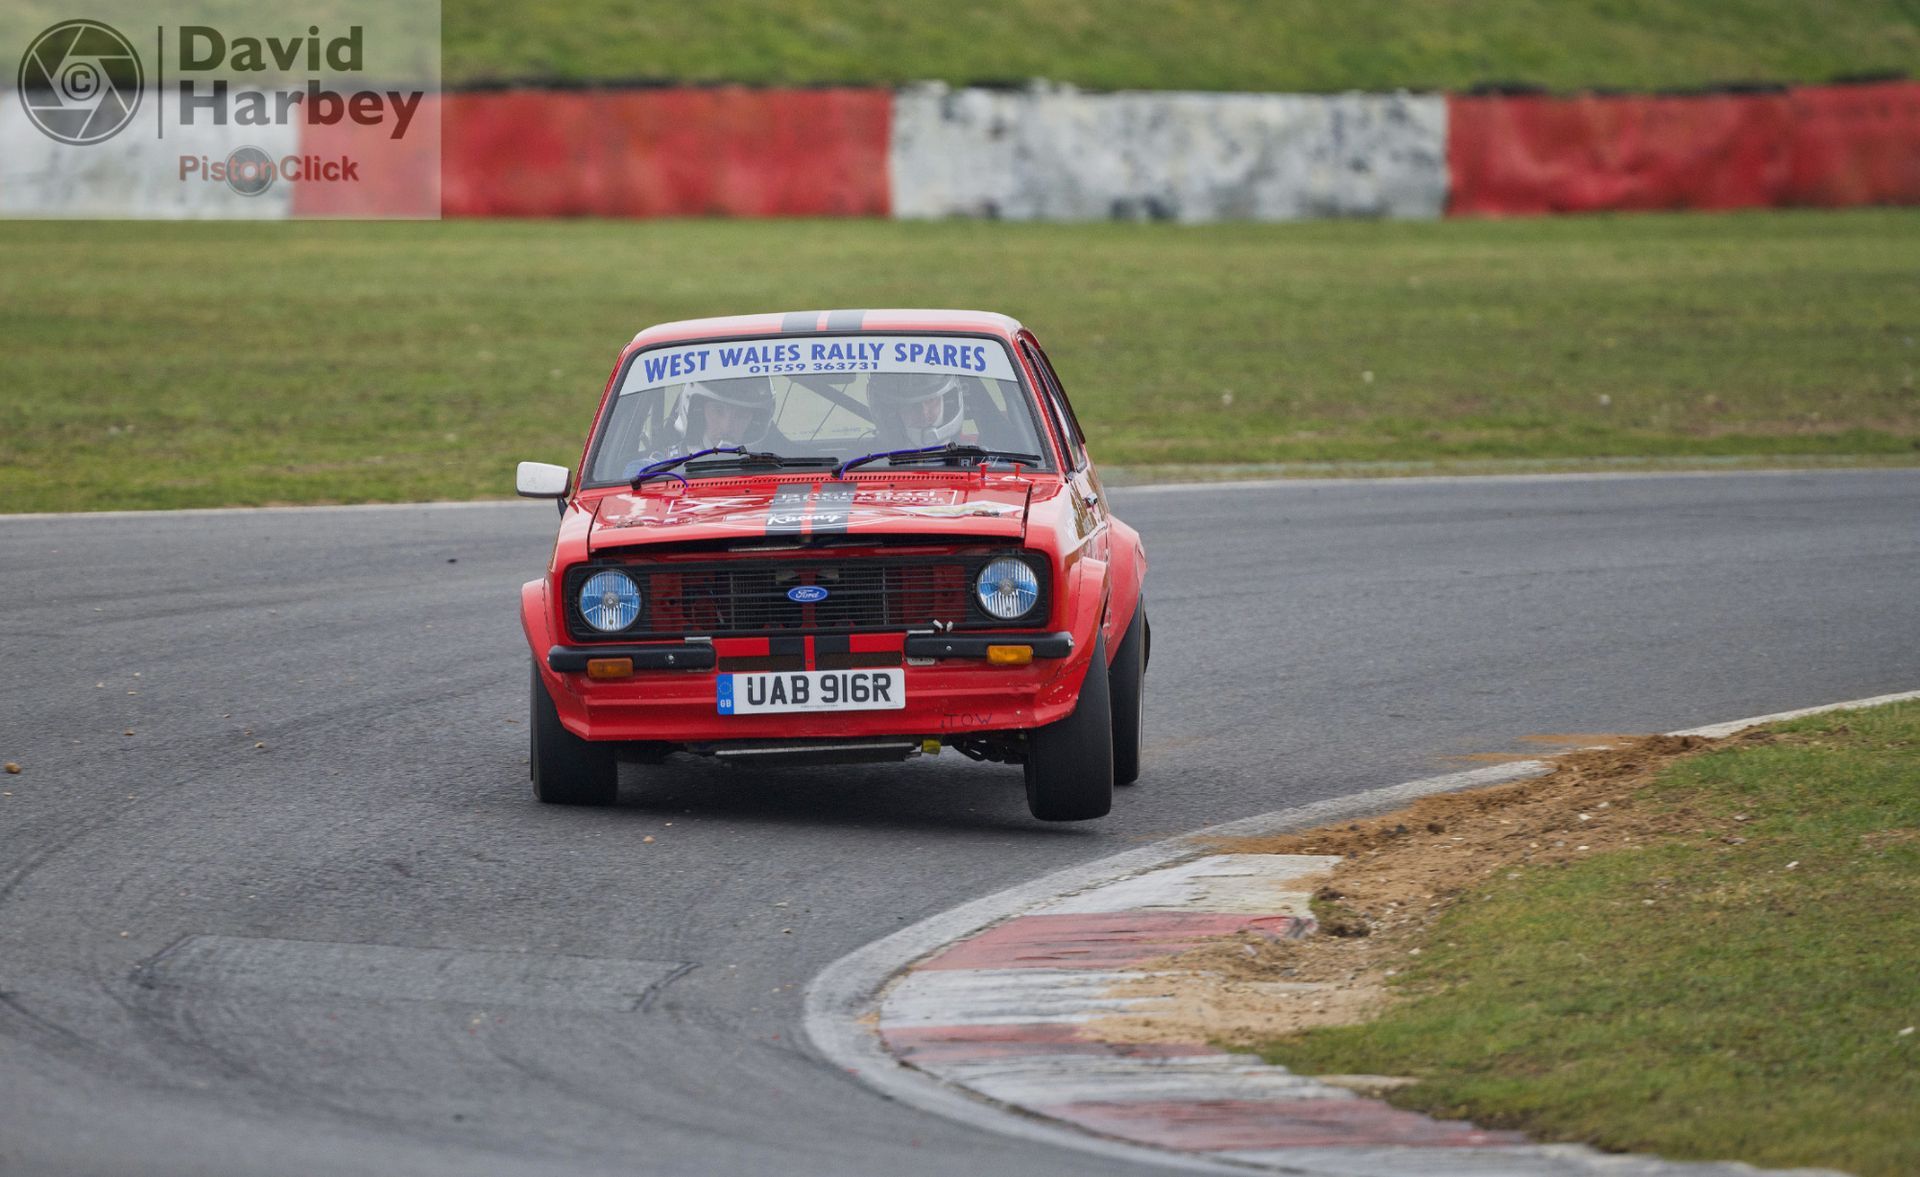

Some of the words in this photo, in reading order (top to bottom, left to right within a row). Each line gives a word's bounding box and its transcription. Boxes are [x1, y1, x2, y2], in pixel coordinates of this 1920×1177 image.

[644, 350, 710, 383] WEST
[718, 344, 801, 368] WALES
[811, 343, 885, 361] RALLY
[894, 343, 987, 372] SPARES
[749, 363, 806, 374] 01559
[813, 362, 878, 371] 363731
[795, 589, 820, 599] Ford
[747, 675, 810, 706] UAB
[820, 673, 891, 703] 916R
[720, 699, 732, 708] GB
